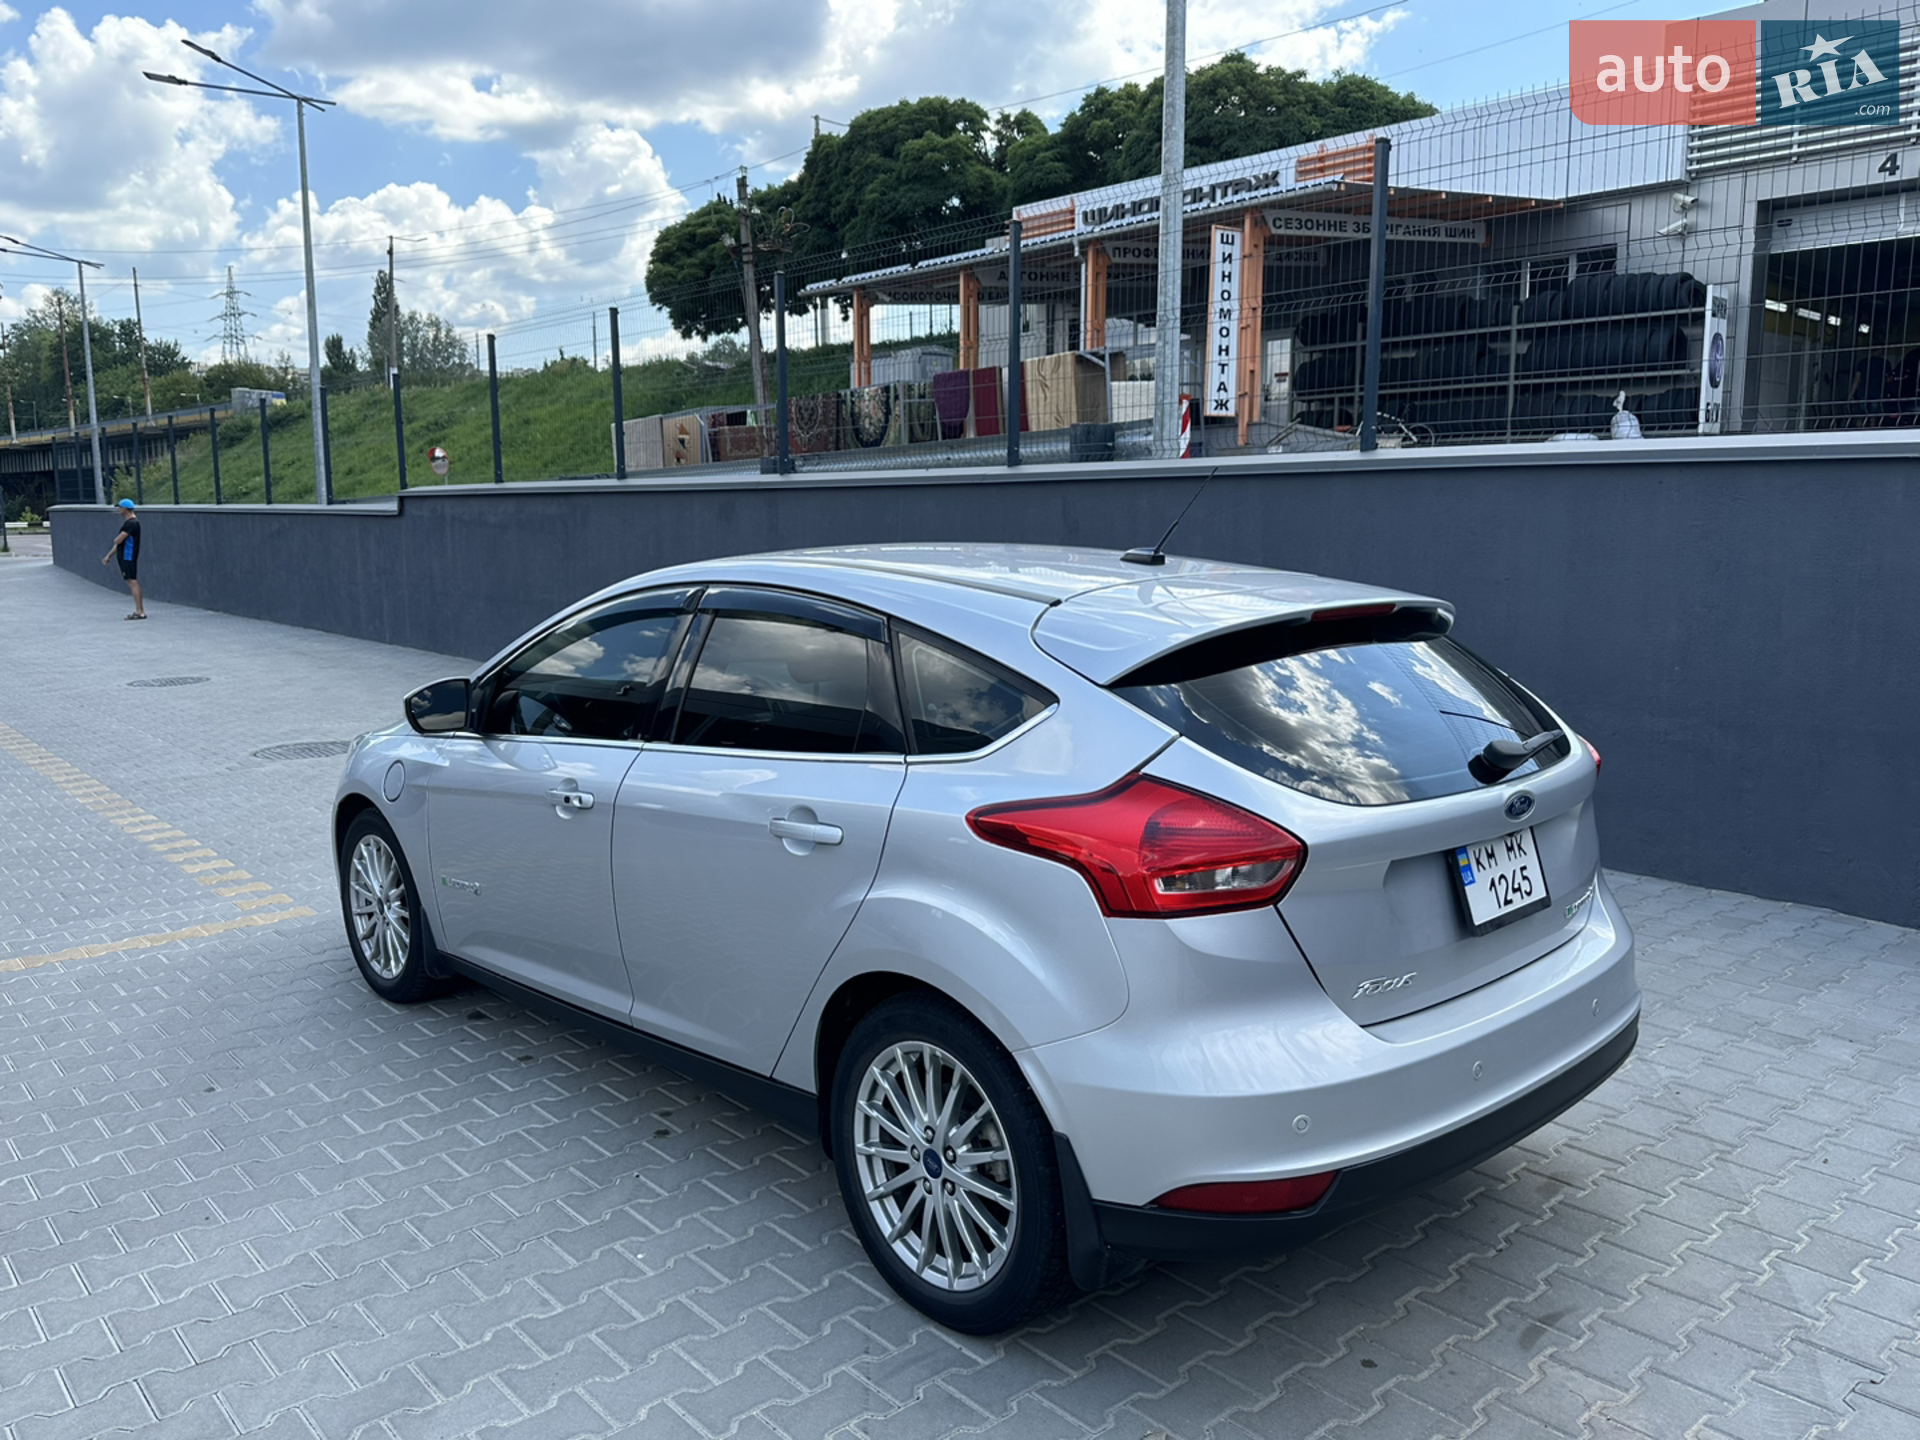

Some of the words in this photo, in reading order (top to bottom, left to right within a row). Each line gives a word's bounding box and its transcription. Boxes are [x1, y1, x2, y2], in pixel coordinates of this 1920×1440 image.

[1878, 152, 1900, 177] 4
[1272, 216, 1348, 233] СЕЗОННЕ
[1352, 221, 1441, 238] ЗБРІГАННЯ
[1444, 226, 1476, 239] ШИН
[997, 271, 1070, 282] АГОННЕ
[1213, 232, 1235, 411] ШИНОМОНТАЖ
[1473, 844, 1498, 873] KM
[1503, 834, 1528, 862] MK
[1461, 871, 1473, 884] UA
[1489, 865, 1533, 909] 1245
